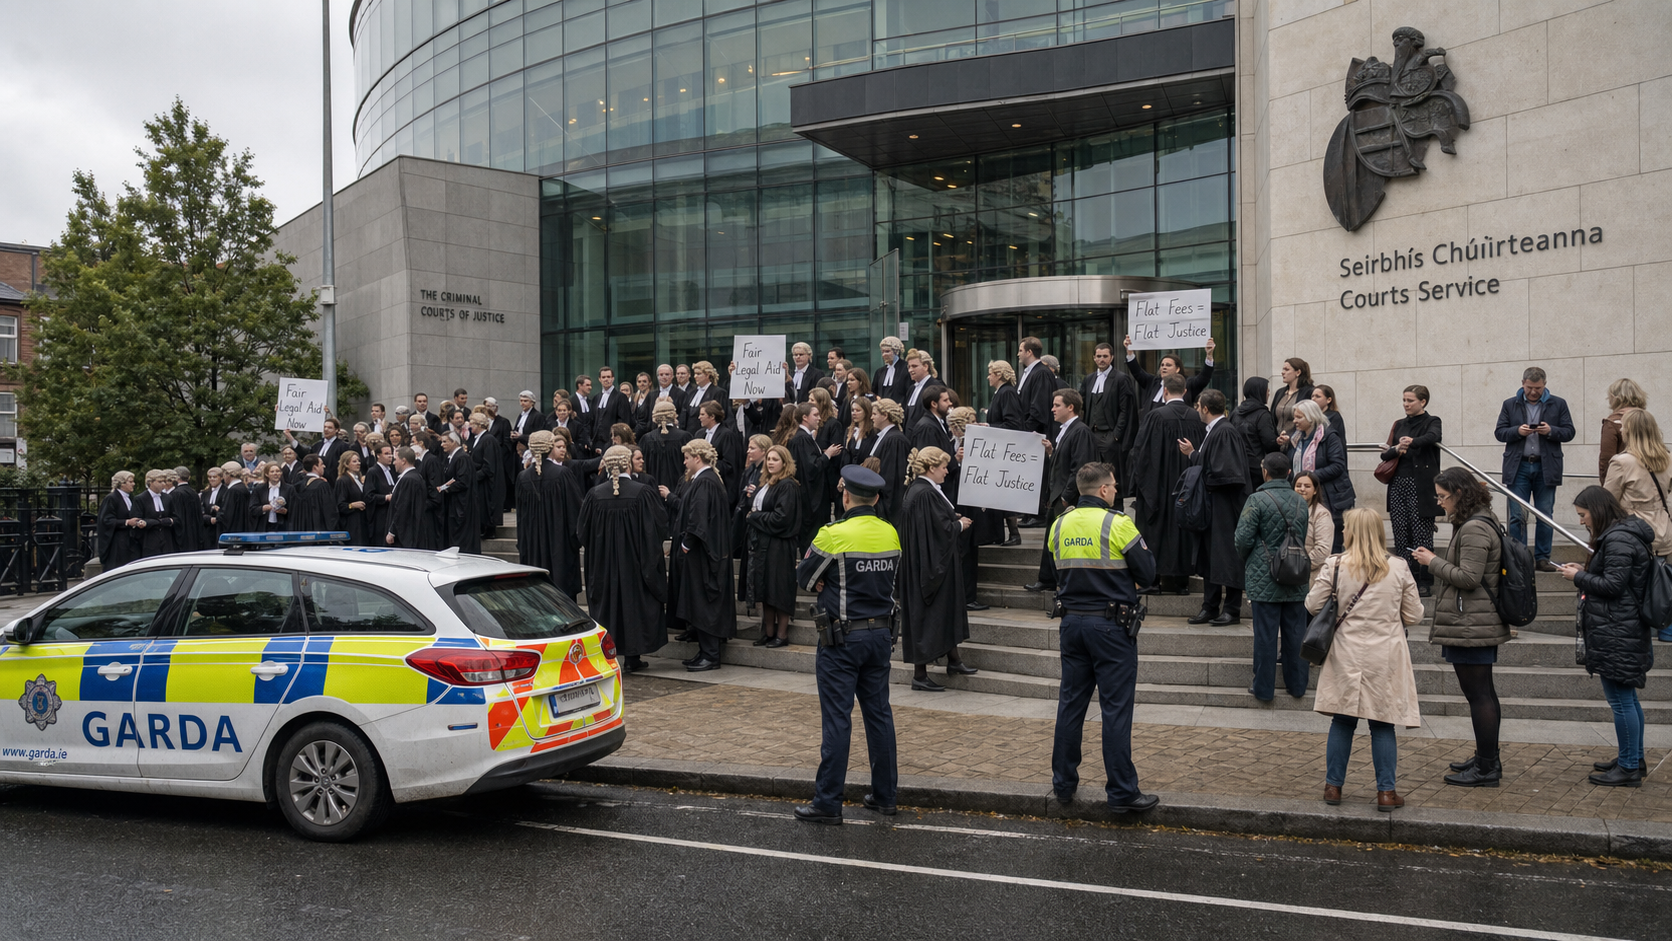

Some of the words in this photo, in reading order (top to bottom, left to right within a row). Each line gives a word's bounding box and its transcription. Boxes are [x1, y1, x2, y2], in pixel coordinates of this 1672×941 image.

[1340, 247, 1424, 278] Seirbhís
[420, 289, 437, 301] THE
[440, 291, 482, 306] CRIMINAL
[1340, 286, 1410, 310] Courts
[1418, 275, 1500, 302] Service
[421, 306, 455, 319] COURTS
[459, 309, 470, 320] OF
[473, 311, 505, 324] JUSTICE
[1136, 300, 1160, 317] Flat
[1168, 298, 1194, 315] Fees
[1134, 323, 1159, 340] Flat
[1167, 321, 1207, 339] Justice
[742, 341, 762, 358] Fair
[735, 361, 760, 380] Legal
[764, 360, 781, 375] Aid
[286, 383, 307, 398] Fair
[744, 381, 766, 395] Now
[279, 399, 303, 417] Legal
[306, 401, 323, 414] Aid
[286, 417, 307, 429] Now
[969, 437, 997, 459] Flat
[1003, 443, 1027, 463] Fees
[964, 465, 989, 486] Flat
[995, 469, 1035, 492] Justice
[1064, 537, 1093, 547] GARDA
[855, 559, 894, 573] GARDA
[82, 711, 243, 753] GARDA
[2, 748, 68, 761] www.garda.ie
